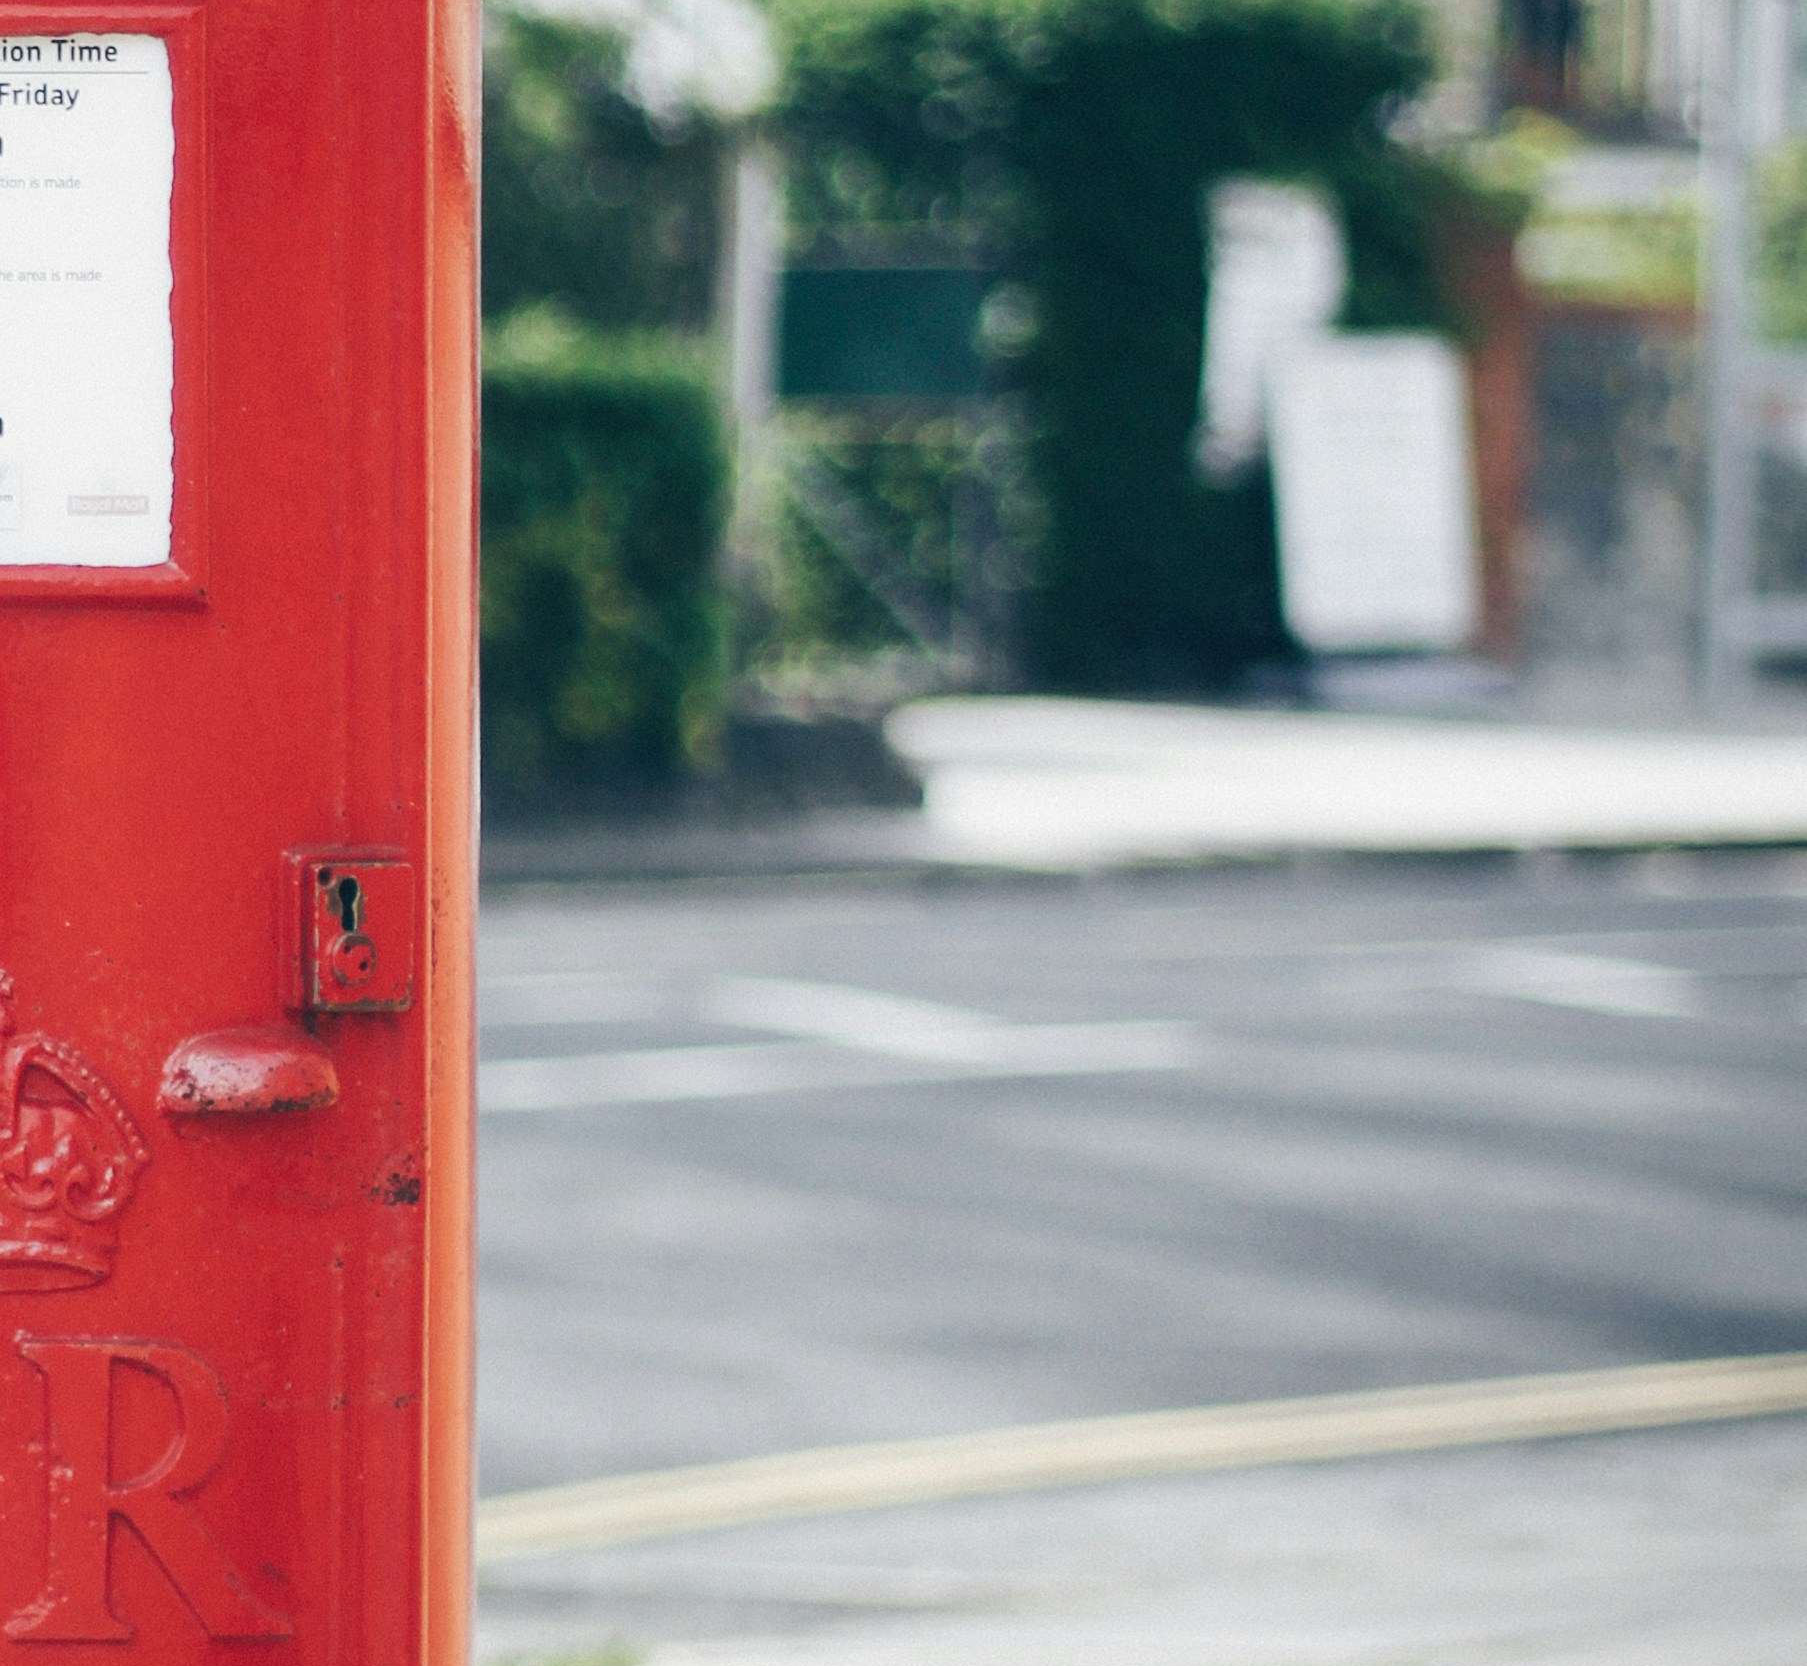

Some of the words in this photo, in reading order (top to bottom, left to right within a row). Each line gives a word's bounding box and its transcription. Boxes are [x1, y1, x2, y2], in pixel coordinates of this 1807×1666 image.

[50, 38, 119, 63] Time
[31, 178, 39, 188] is
[45, 177, 81, 188] made
[18, 272, 46, 281] area
[51, 270, 60, 281] is
[66, 269, 101, 281] made
